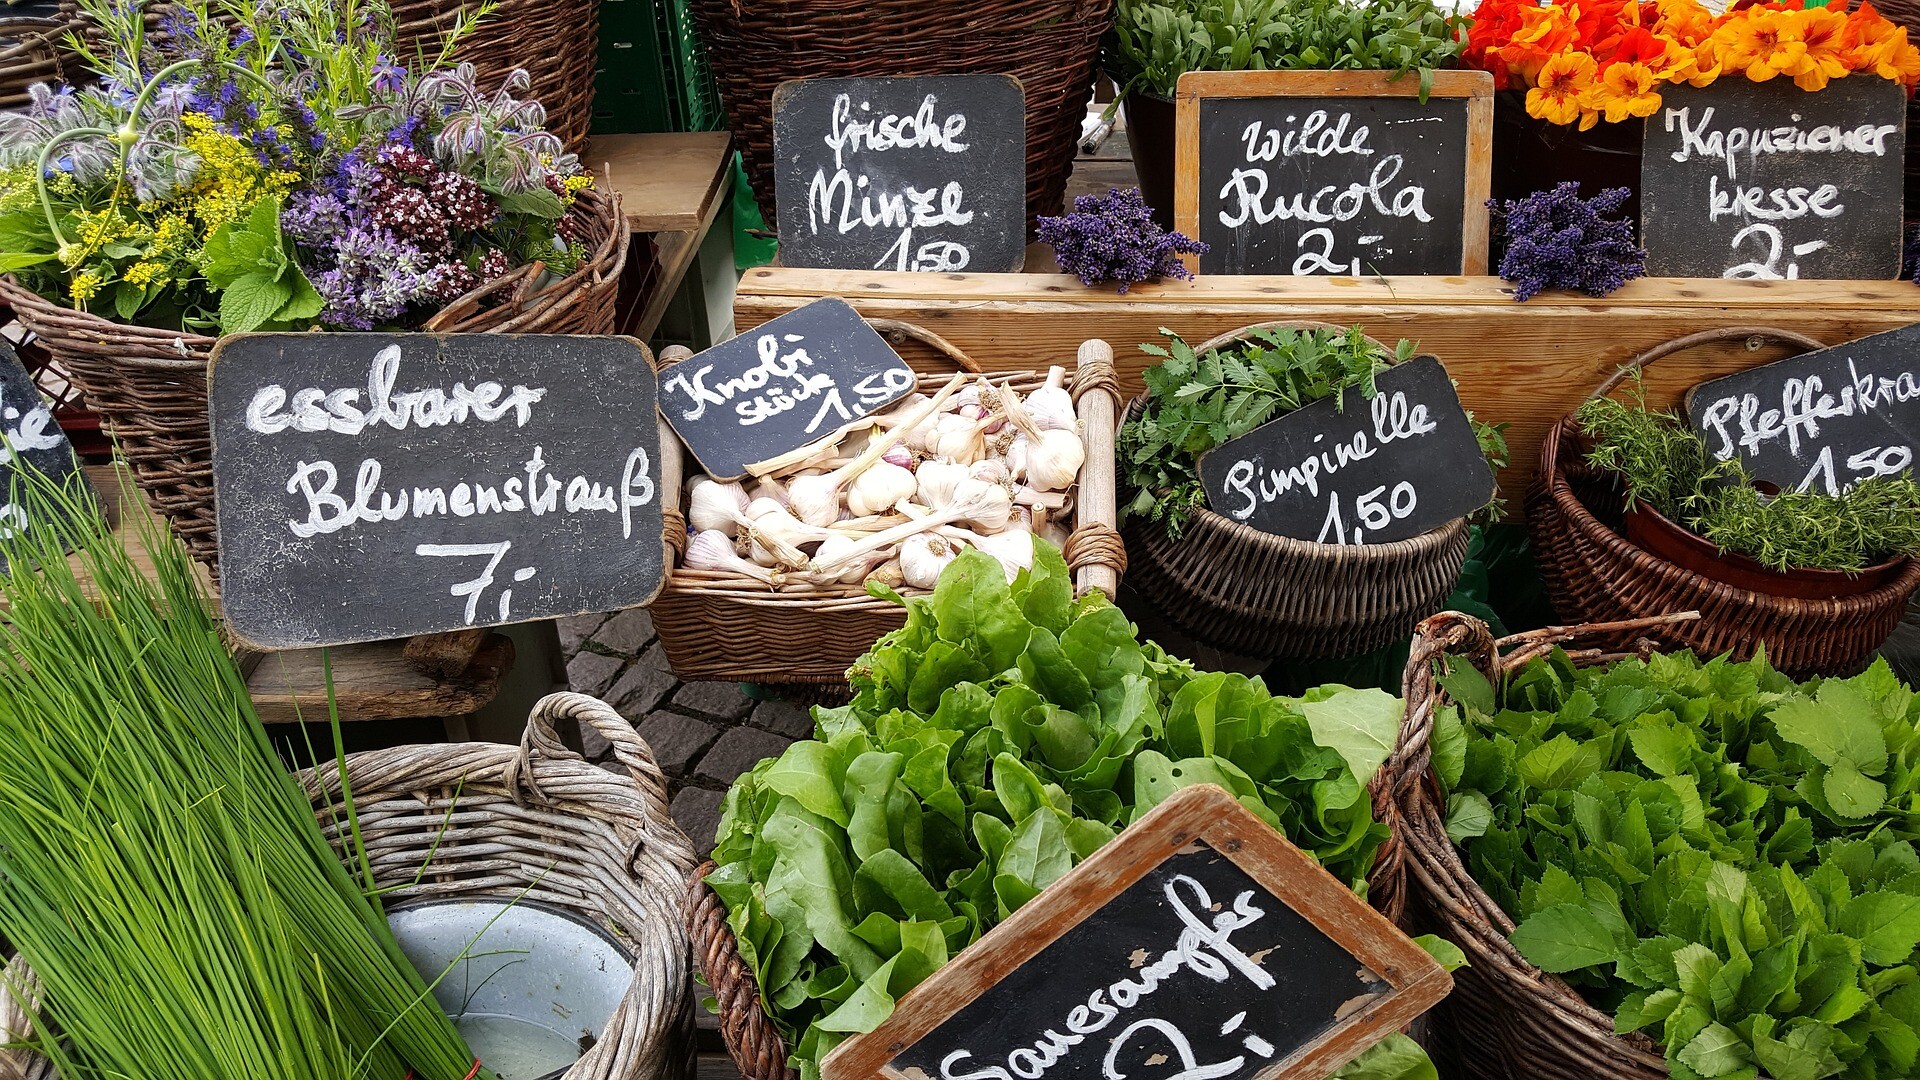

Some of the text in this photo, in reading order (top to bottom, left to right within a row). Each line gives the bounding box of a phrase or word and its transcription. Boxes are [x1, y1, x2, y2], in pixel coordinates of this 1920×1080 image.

[824, 94, 970, 169] frische
[1241, 110, 1374, 162] wilde
[809, 169, 974, 235] Minze
[1219, 154, 1434, 228] Rucola
[874, 227, 970, 272] 1,50
[246, 344, 547, 434] essbarer
[665, 334, 814, 421] Knobi
[804, 368, 915, 433] 1,50
[0, 400, 63, 464] ie
[1223, 391, 1437, 520] Pimpinelle
[287, 446, 655, 539] Blumenstrauß
[1317, 480, 1417, 546] 1,50
